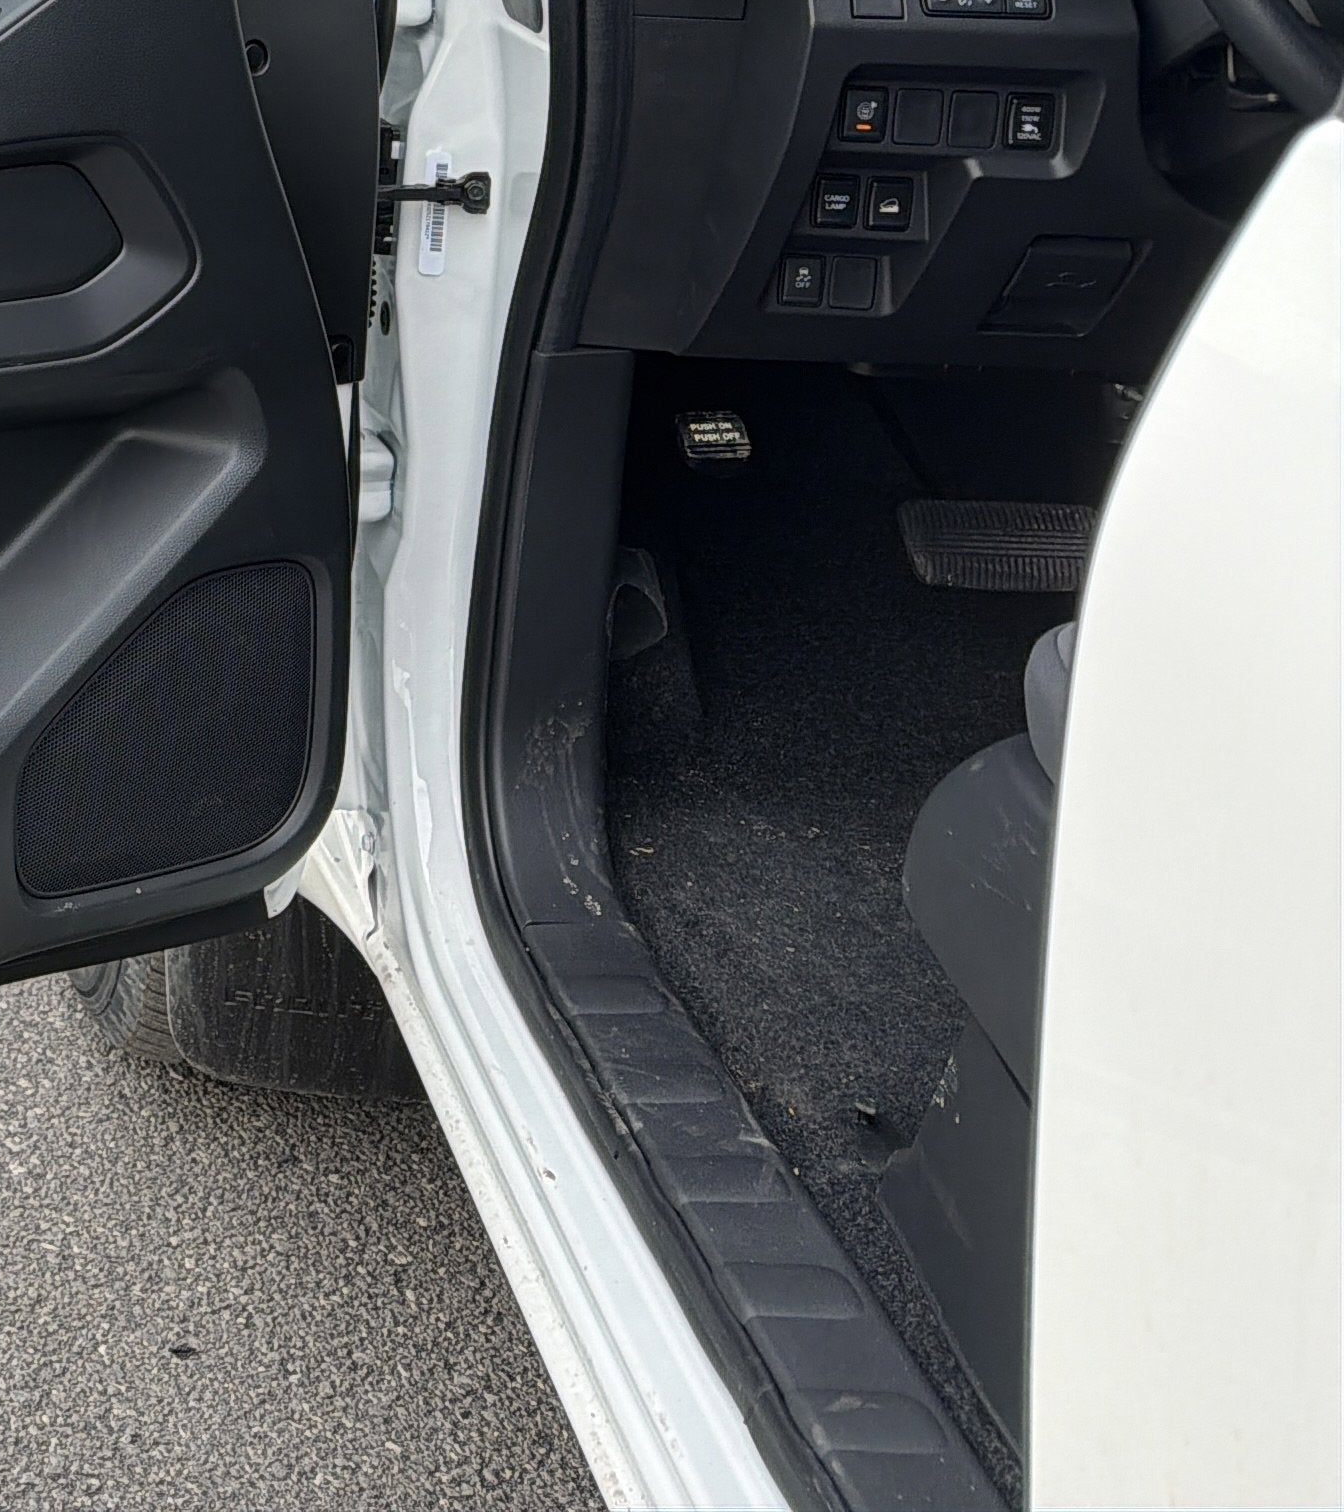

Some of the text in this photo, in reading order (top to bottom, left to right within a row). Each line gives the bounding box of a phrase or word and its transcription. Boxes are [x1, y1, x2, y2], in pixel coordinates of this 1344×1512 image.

[824, 194, 851, 203] CARGO
[825, 202, 847, 210] LAMP
[795, 281, 811, 289] OFF
[690, 423, 716, 431] PUSH
[694, 432, 741, 442] PUSH OFF
